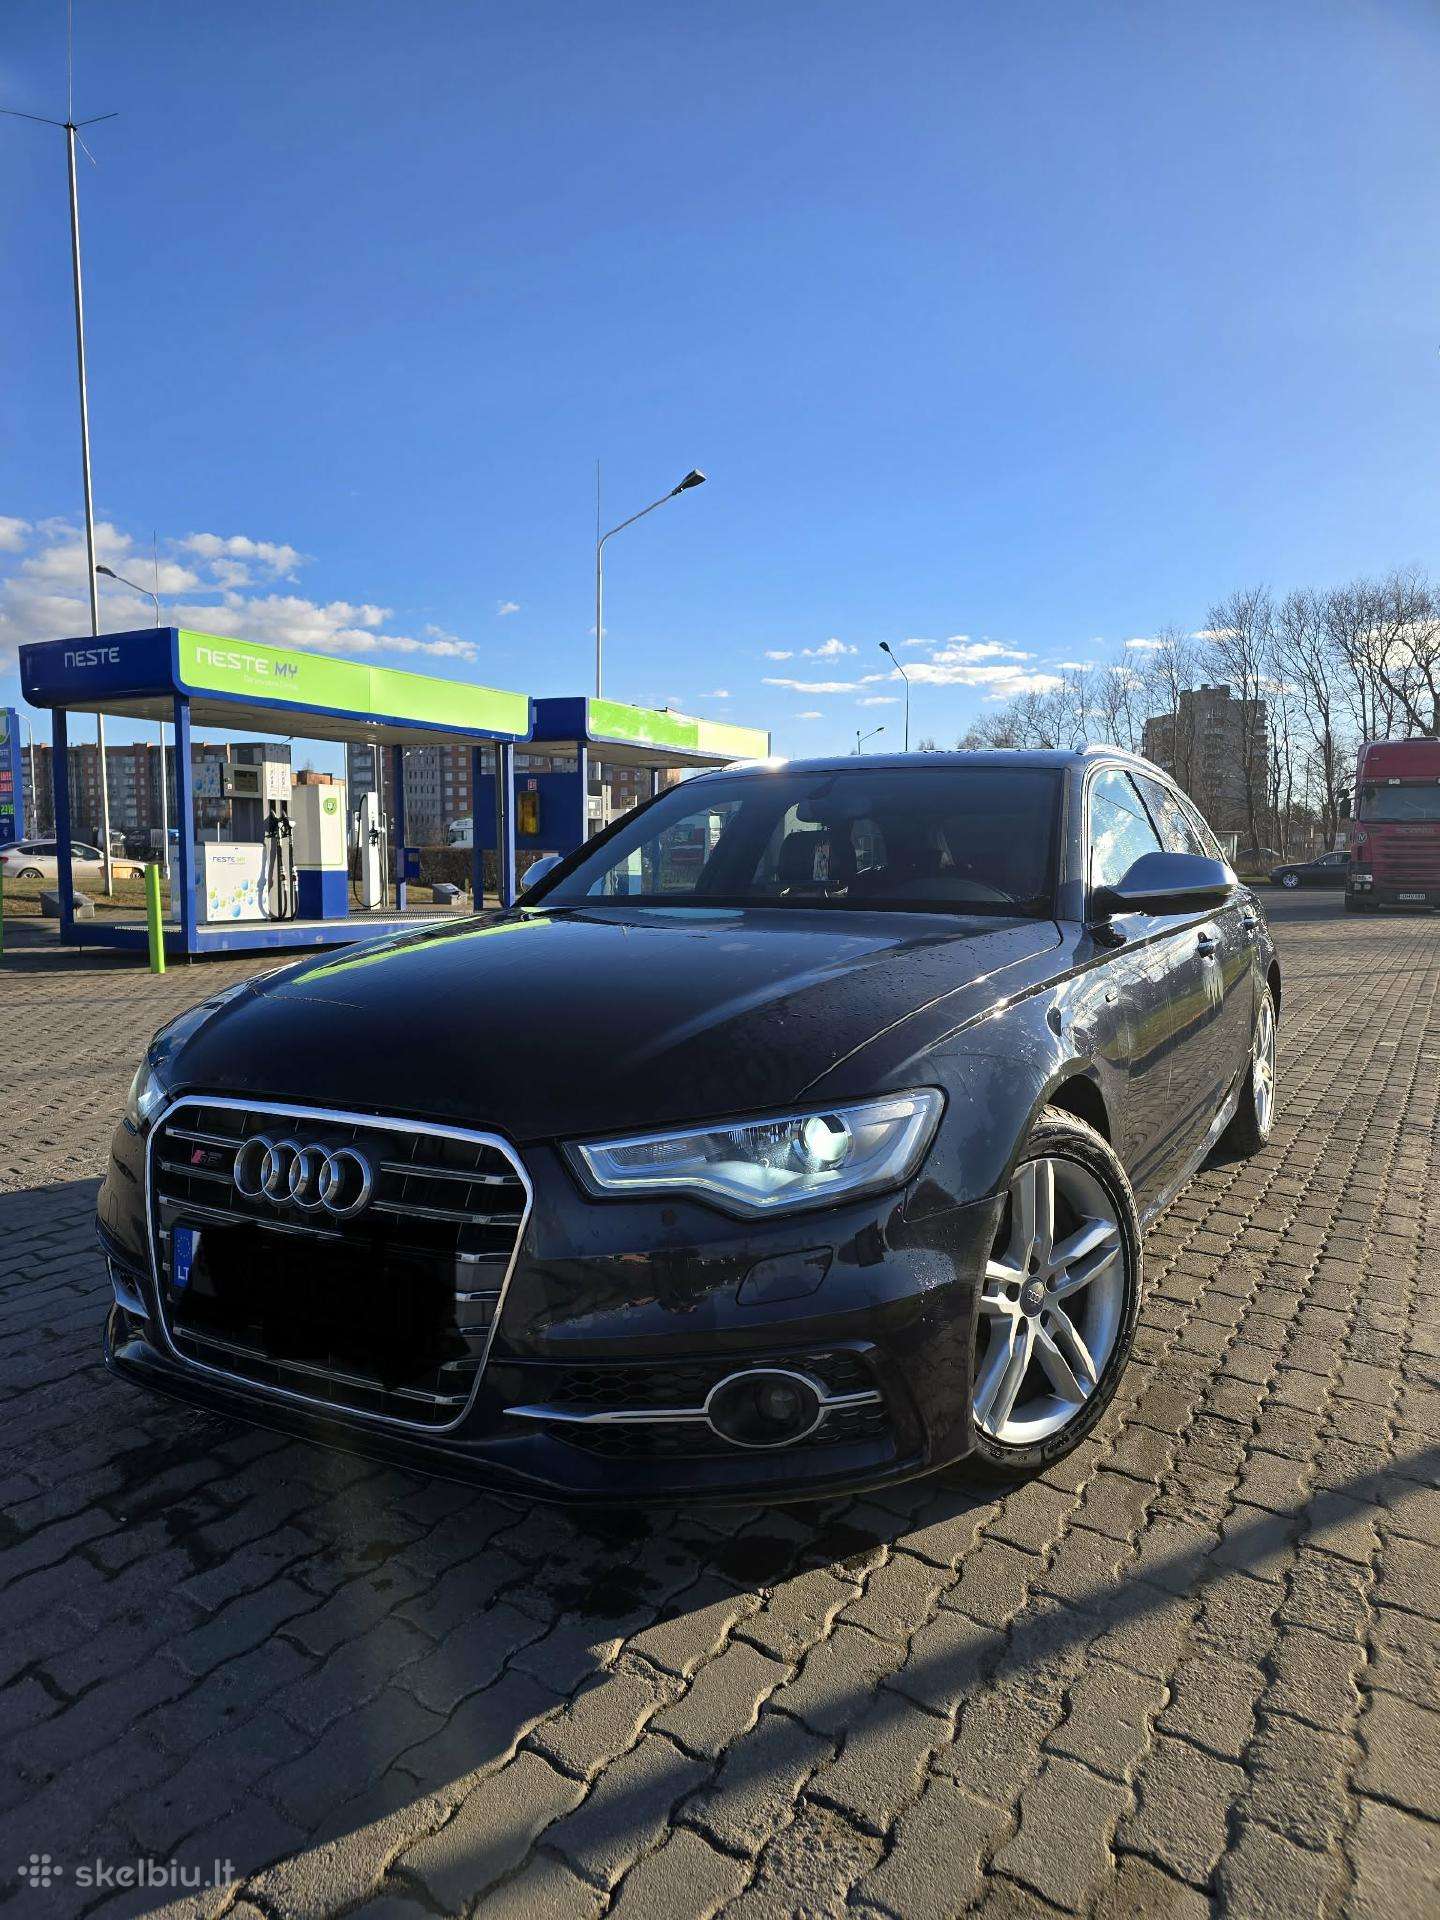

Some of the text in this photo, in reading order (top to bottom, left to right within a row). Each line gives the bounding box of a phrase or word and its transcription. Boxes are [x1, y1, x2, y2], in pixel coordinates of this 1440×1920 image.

[65, 646, 120, 668] NESTE
[195, 647, 298, 679] NESTE MY
[178, 1264, 190, 1280] LT
